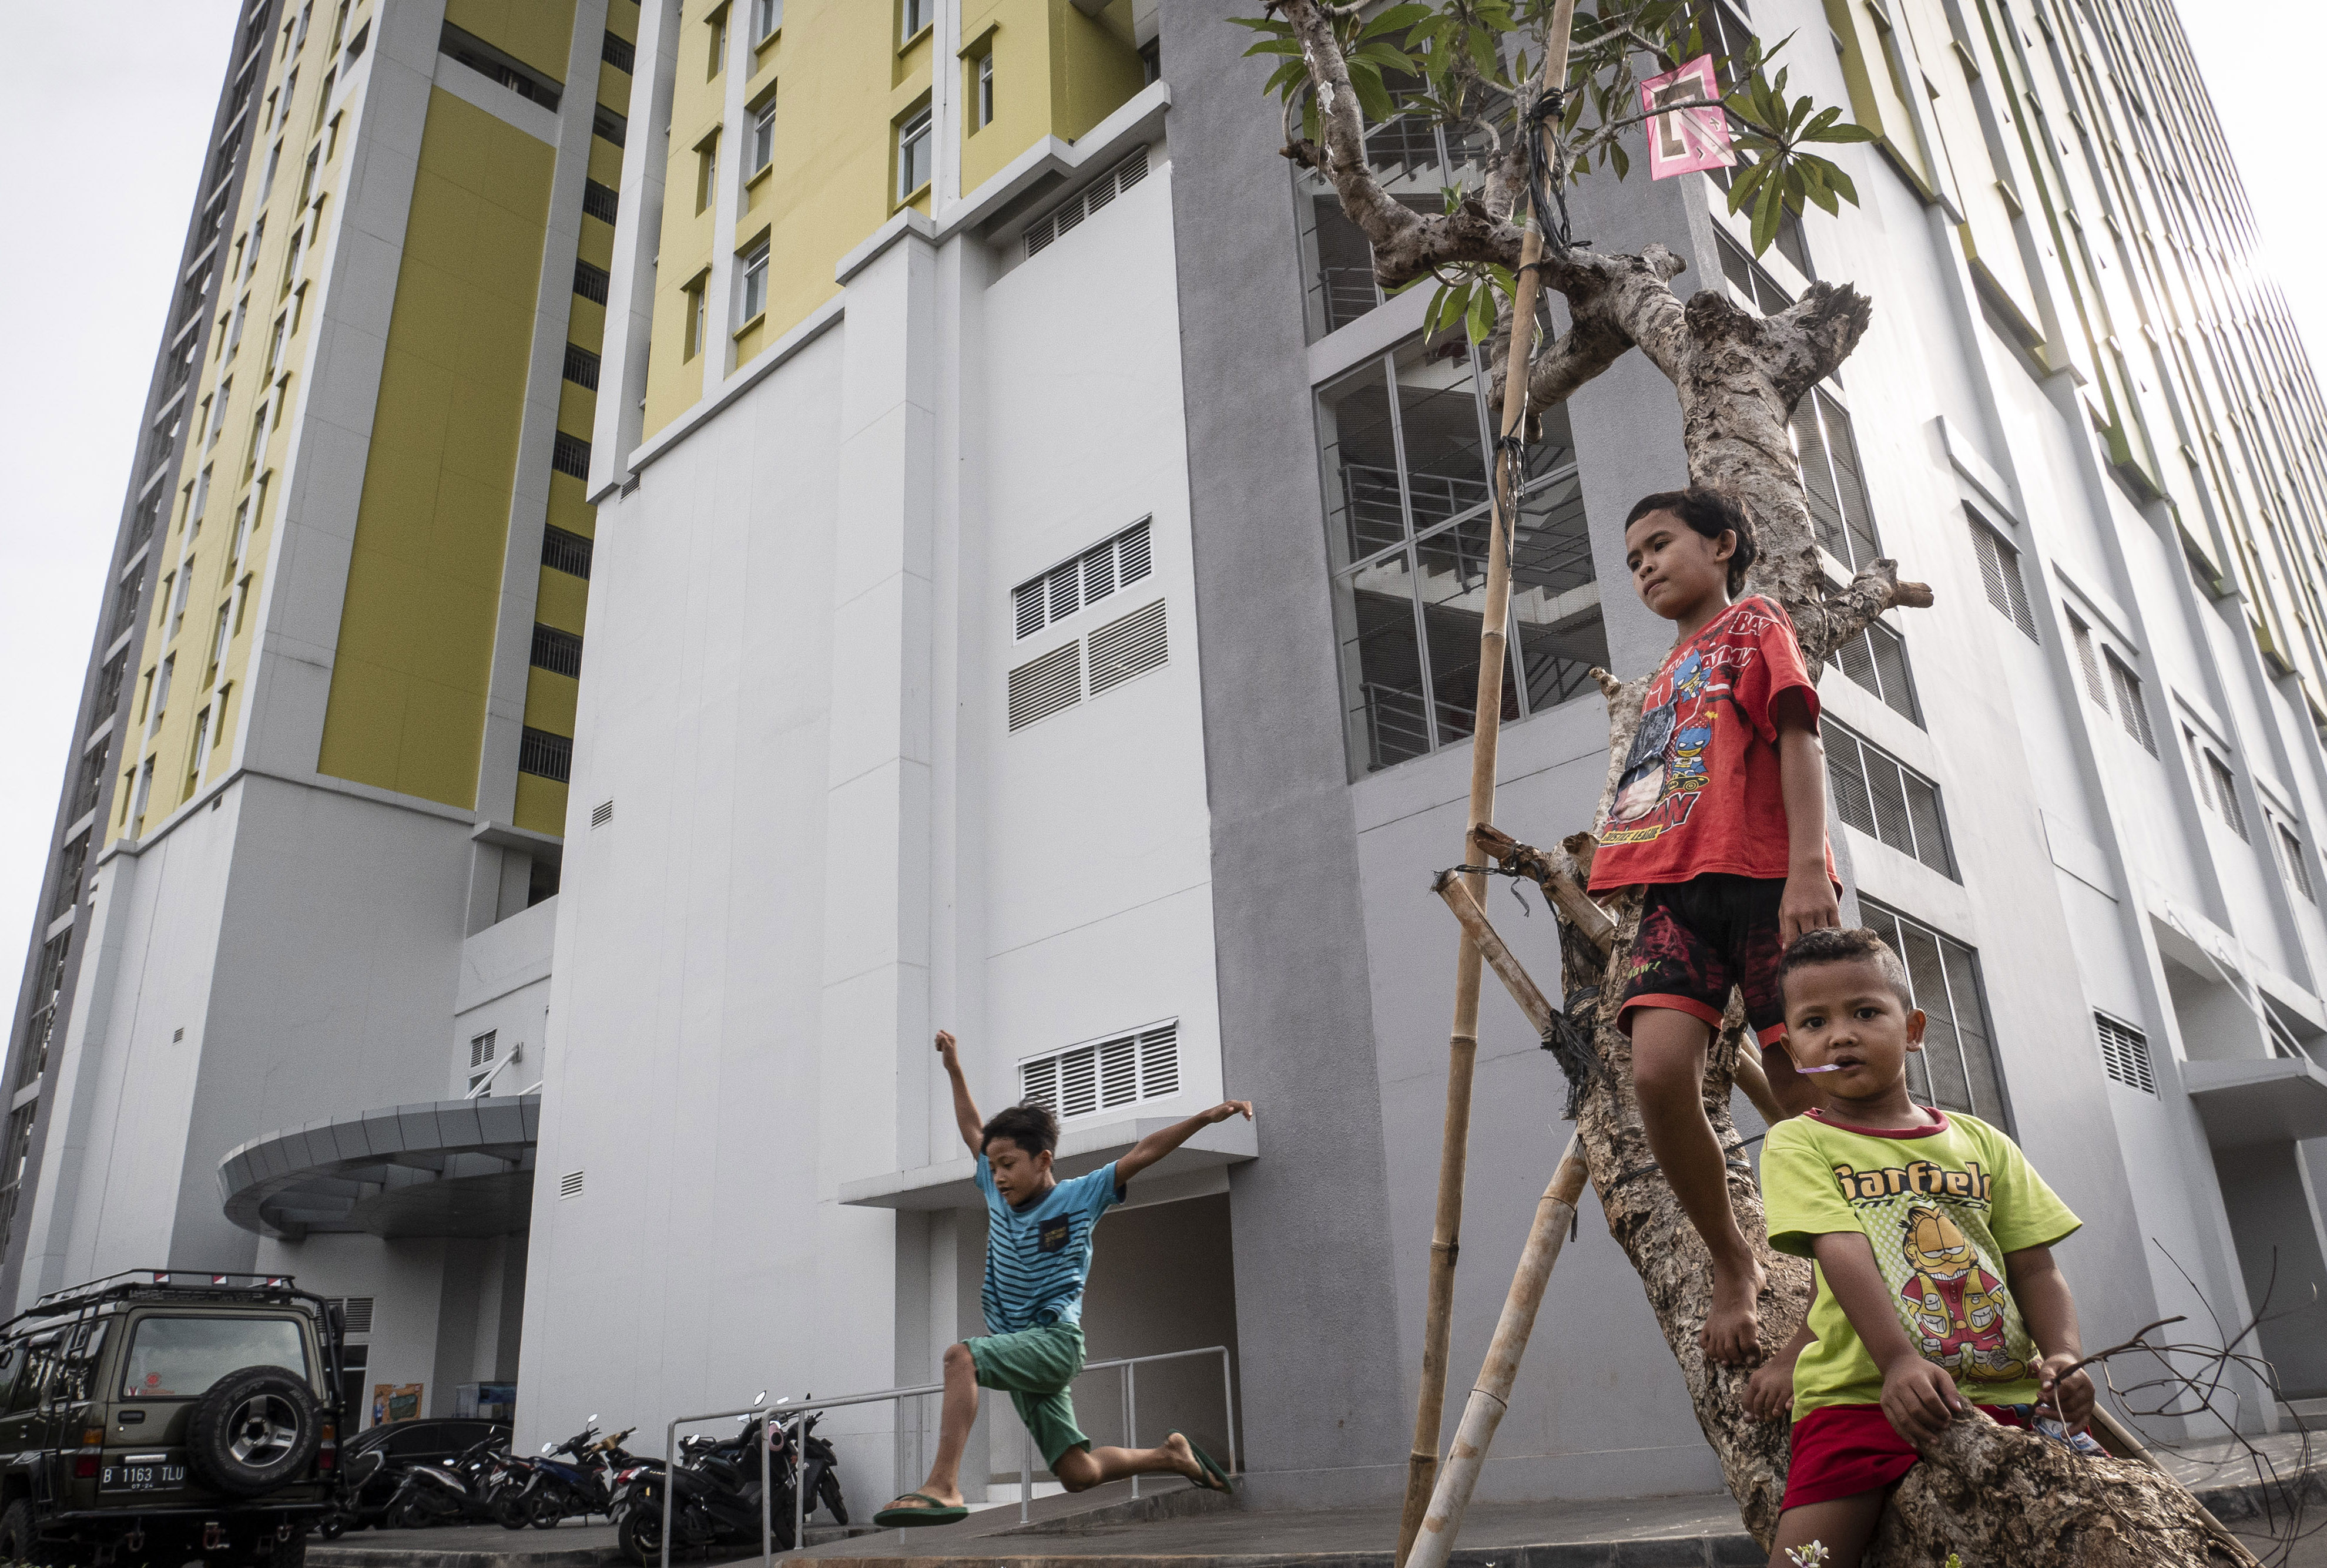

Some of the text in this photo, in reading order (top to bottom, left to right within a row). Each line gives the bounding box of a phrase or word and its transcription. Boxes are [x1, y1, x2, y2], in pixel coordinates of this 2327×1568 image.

[103, 1467, 183, 1483] B 1163 TLU
